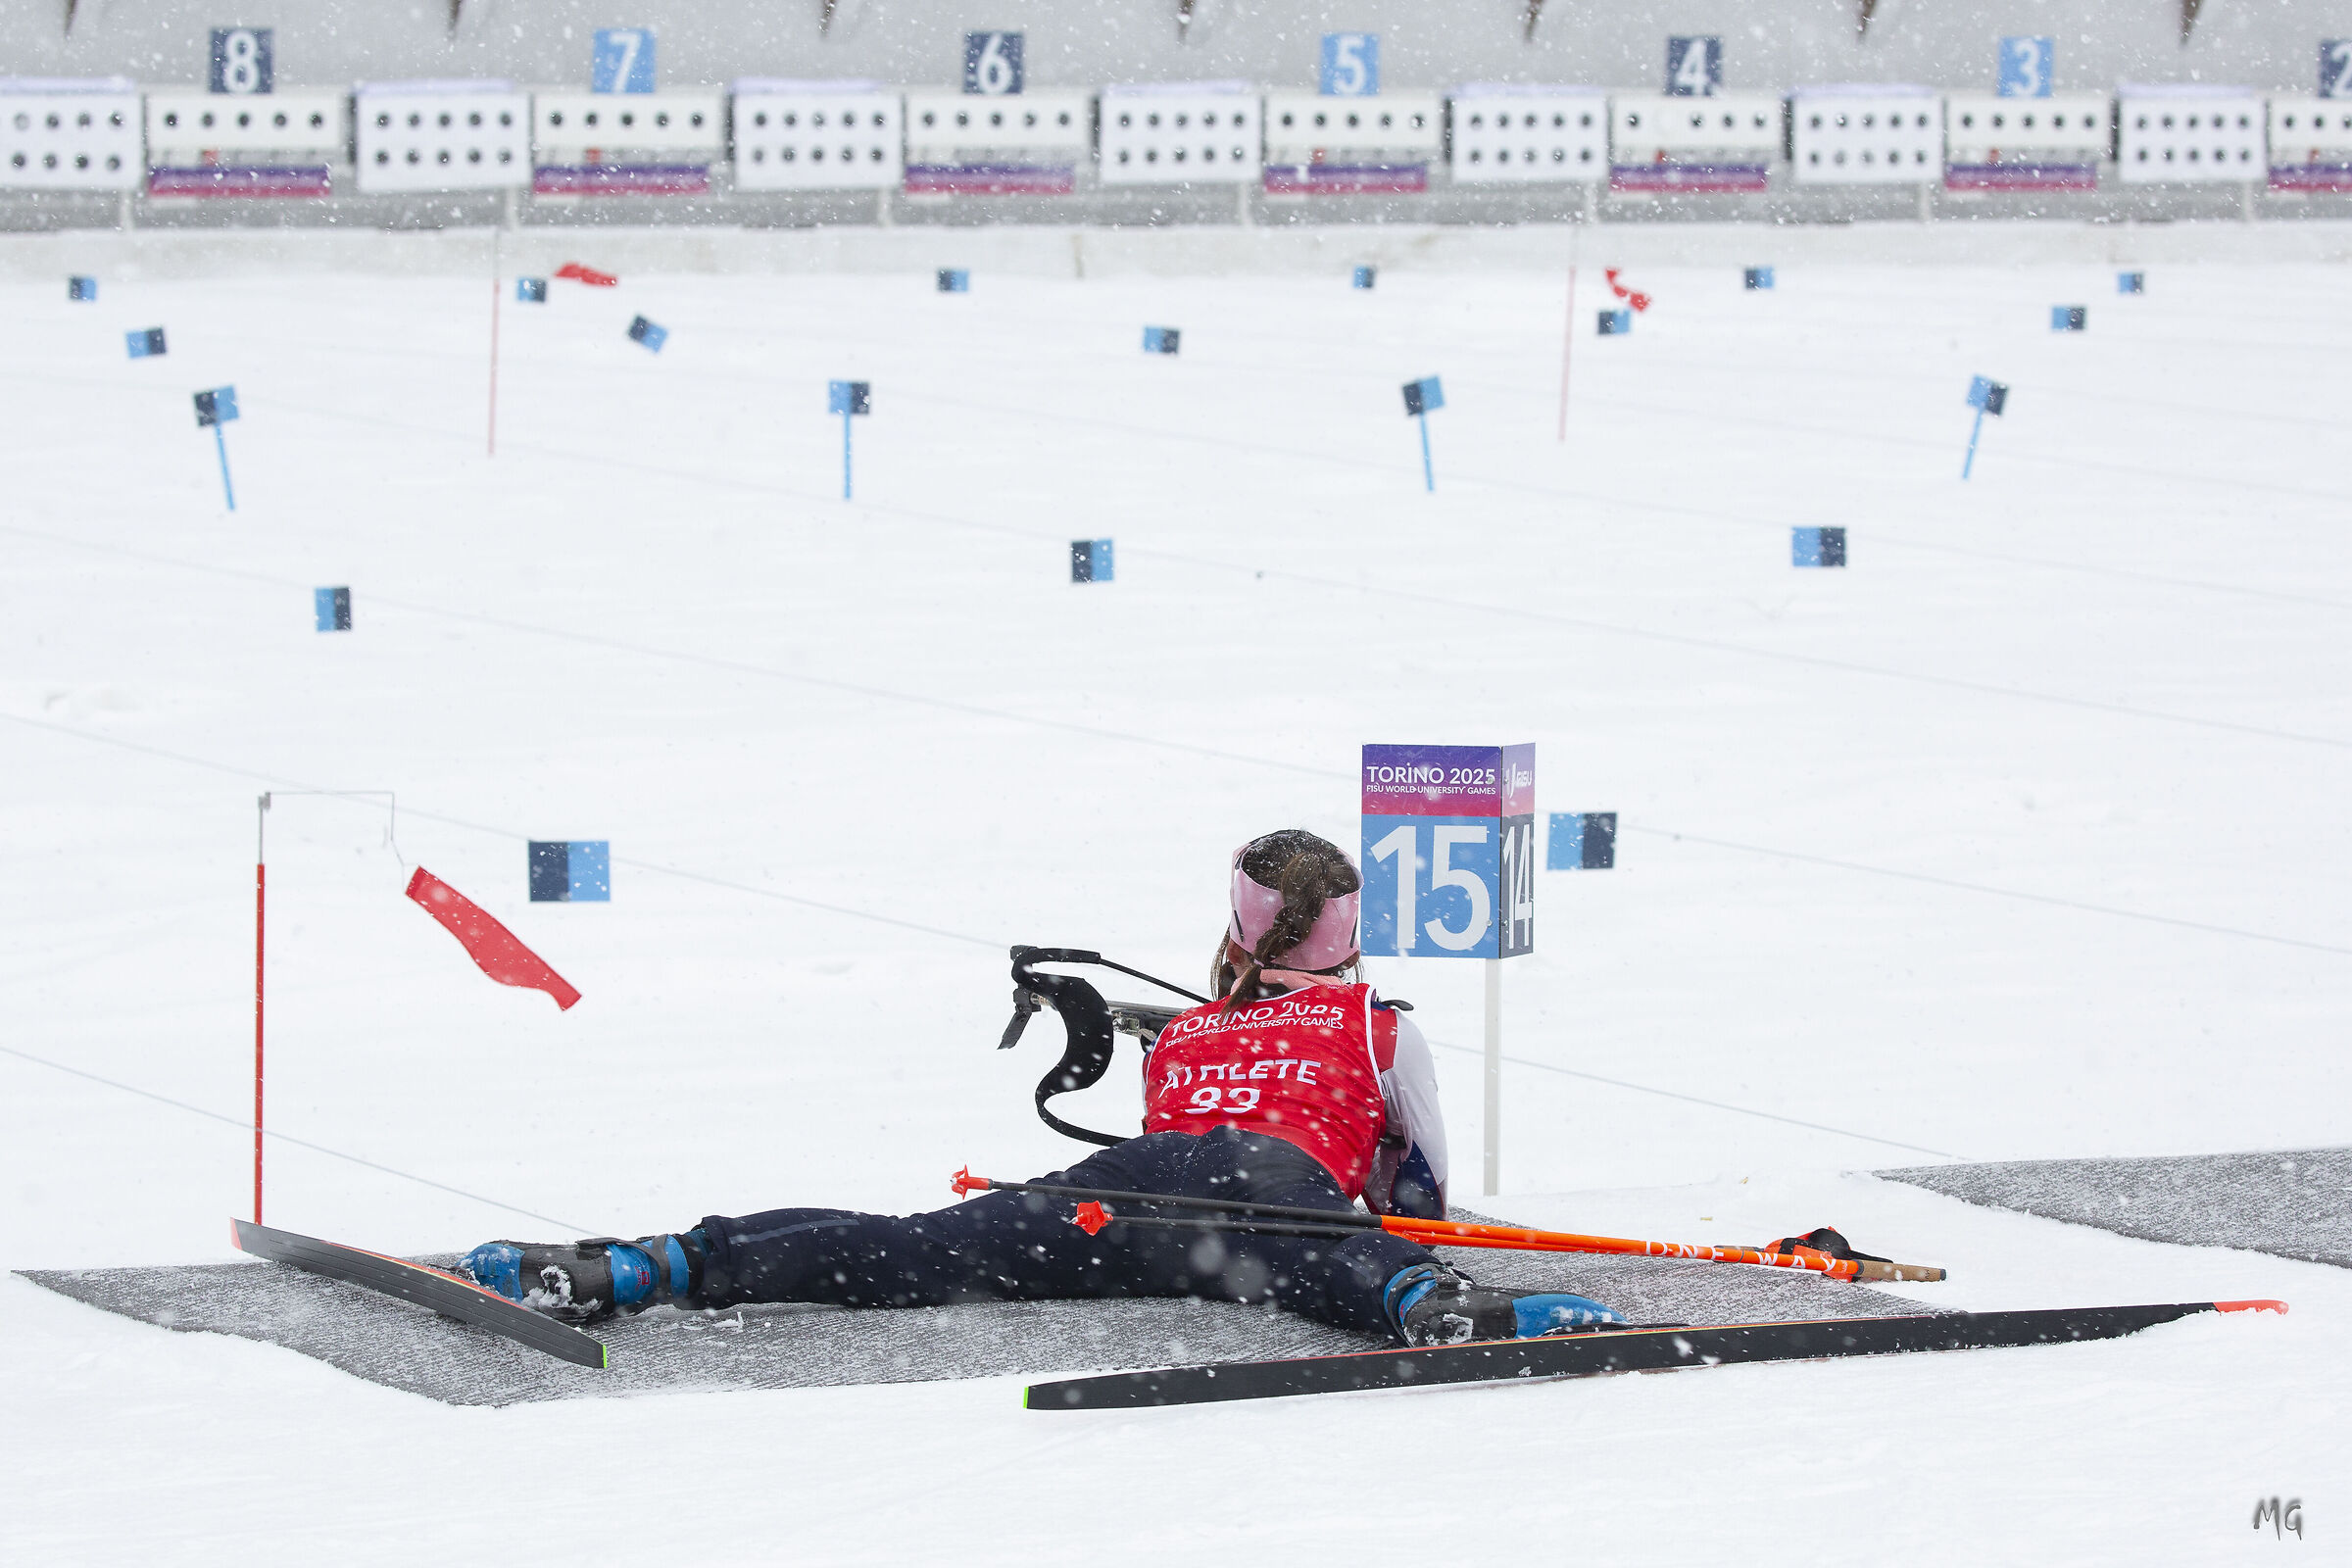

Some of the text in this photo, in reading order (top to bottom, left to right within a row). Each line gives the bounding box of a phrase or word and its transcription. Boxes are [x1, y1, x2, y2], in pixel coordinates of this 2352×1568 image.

[224, 30, 260, 94] 8
[610, 31, 642, 94] 7
[978, 31, 1012, 94] 6
[1334, 35, 1365, 95] 5
[1675, 37, 1710, 96] 4
[2010, 39, 2040, 96] 3
[2331, 43, 2352, 97] 2
[1366, 784, 1384, 793] FISU
[1385, 785, 1416, 794] WORLD
[1417, 786, 1466, 795] UNIVERSITY
[1449, 767, 1495, 785] 2025
[1370, 825, 1491, 951] 15
[1503, 824, 1533, 950] 14
[1172, 1001, 1346, 1038] TORINO 2025
[1187, 1025, 1231, 1039] WORLD
[1232, 1017, 1300, 1031] UNIVERSITY
[1301, 1016, 1344, 1030] GAMES
[1158, 1059, 1322, 1099] ATHLETE
